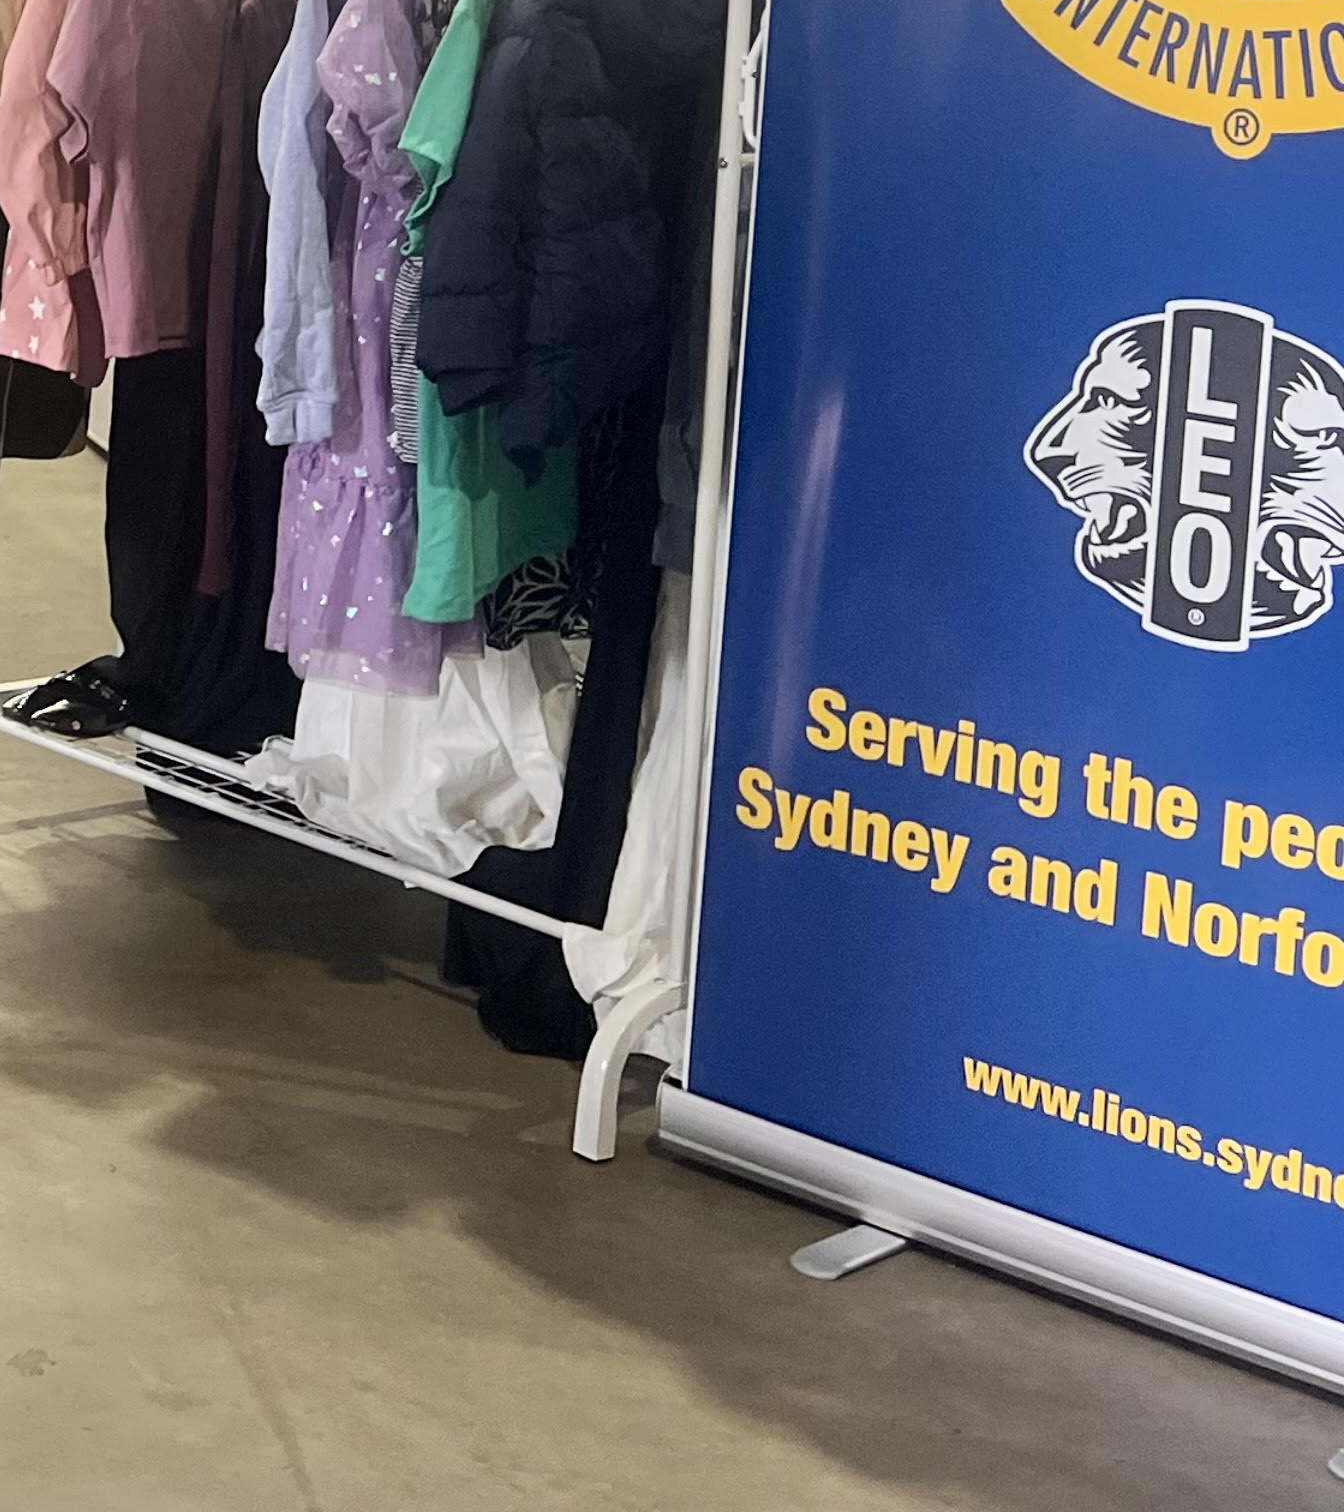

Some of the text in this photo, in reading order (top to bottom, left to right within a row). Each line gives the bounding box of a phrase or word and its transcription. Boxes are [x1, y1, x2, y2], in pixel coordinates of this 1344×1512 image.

[1170, 326, 1240, 605] LEO
[807, 687, 1060, 822] Serving
[1084, 760, 1196, 841] the
[736, 766, 1344, 989] Sydney and Norfo
